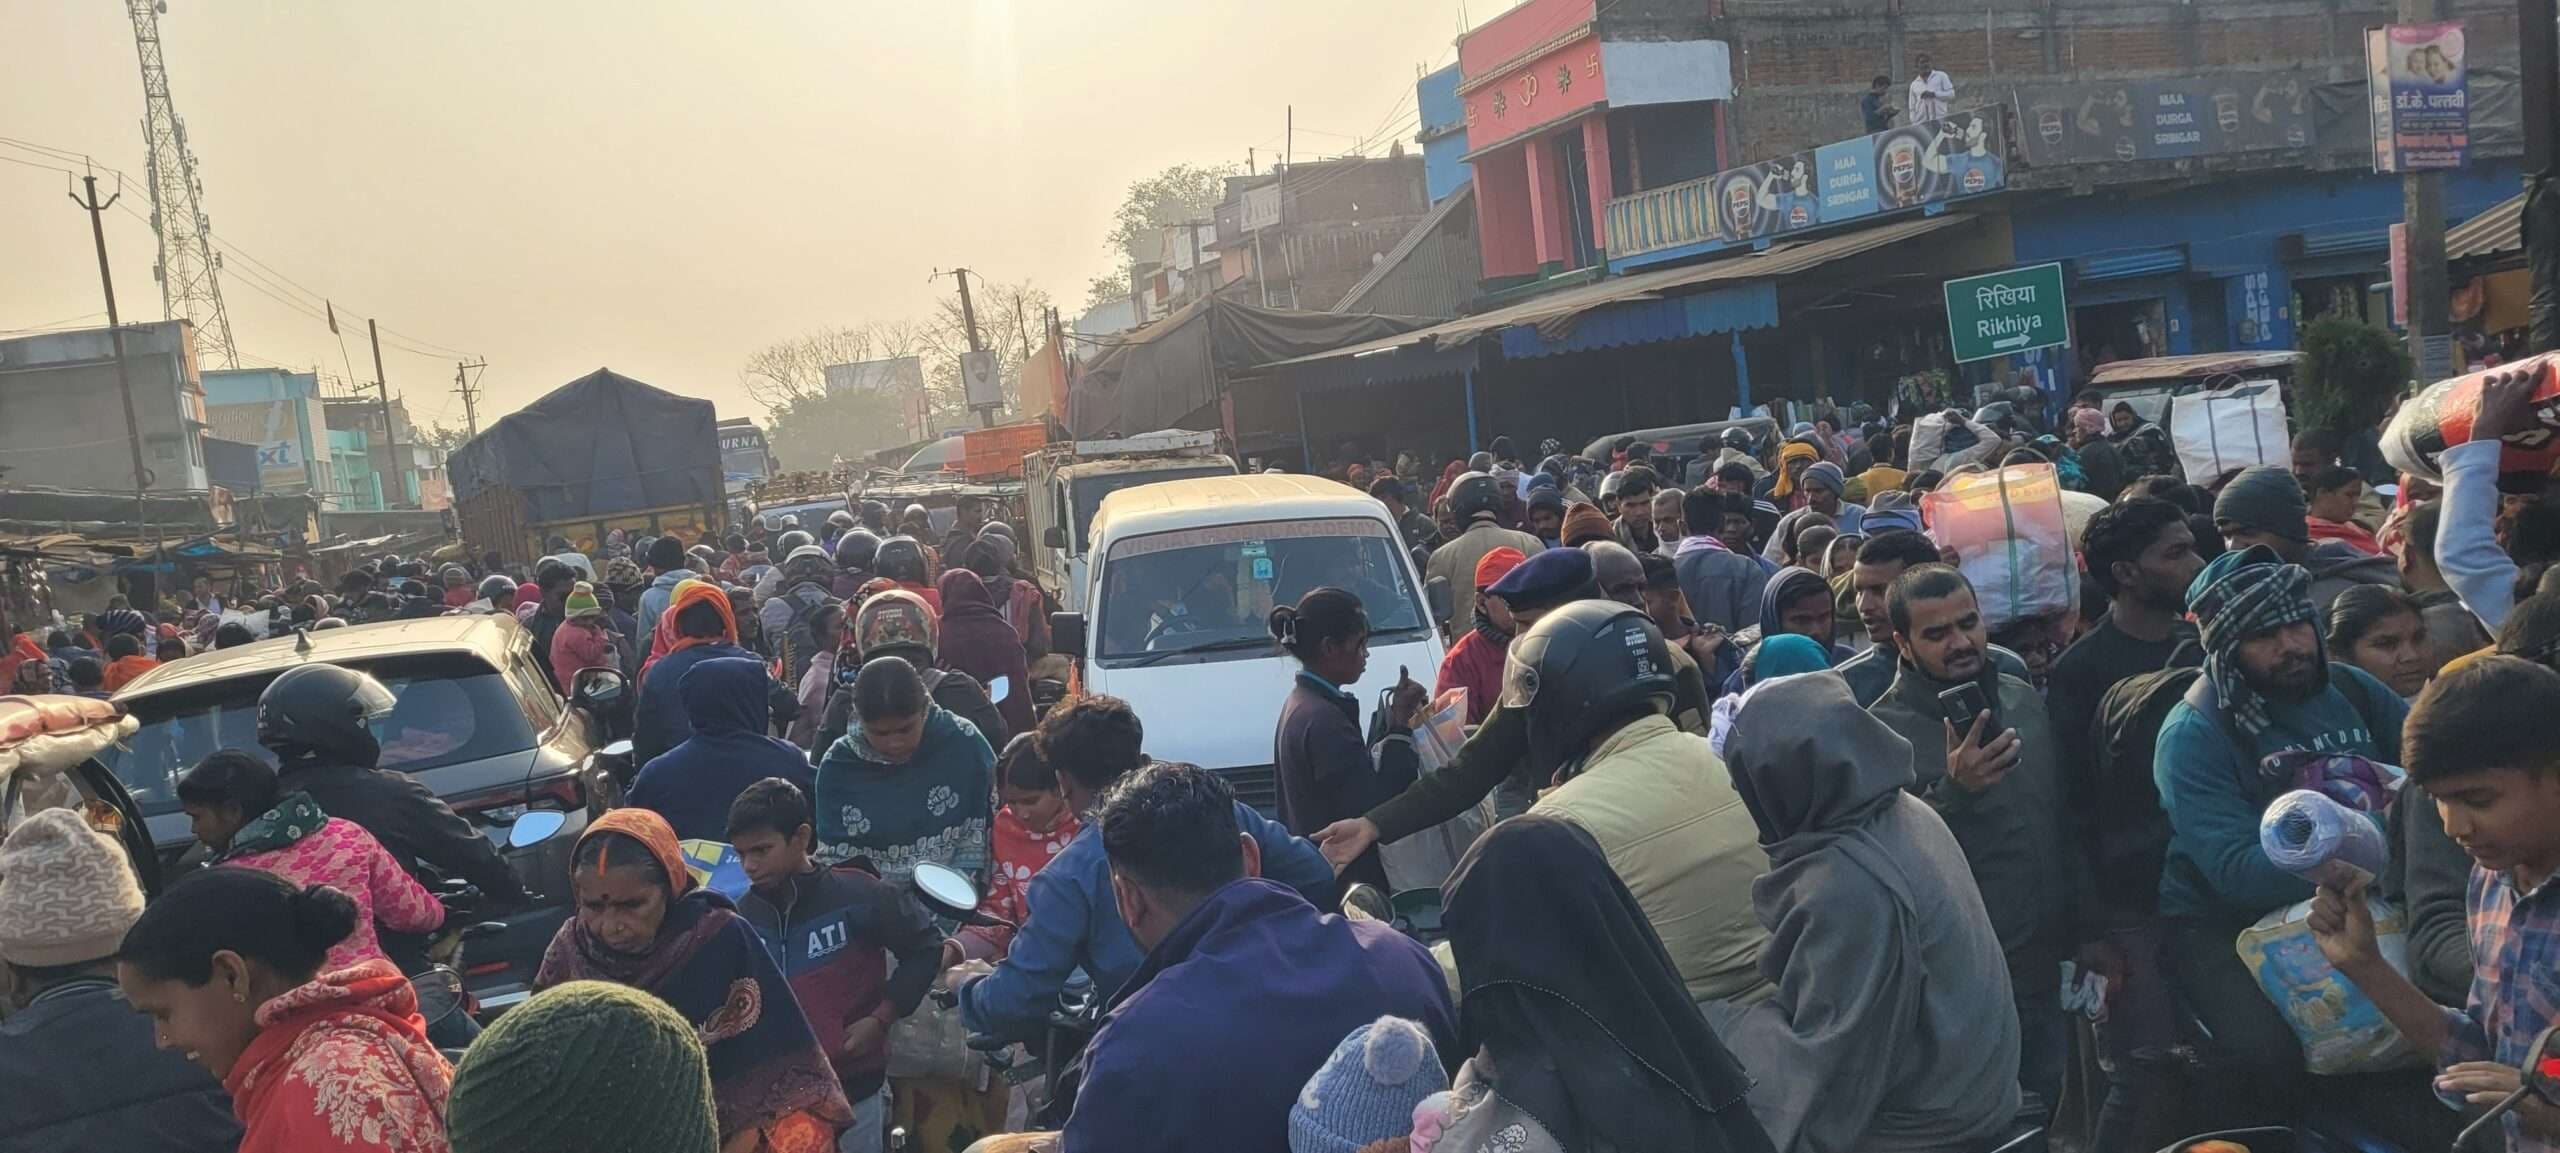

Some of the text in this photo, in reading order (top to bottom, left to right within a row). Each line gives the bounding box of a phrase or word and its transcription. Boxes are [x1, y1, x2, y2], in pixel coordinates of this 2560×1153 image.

[2159, 94, 2185, 106] MAA
[2155, 112, 2193, 126] DURGA
[1833, 155, 1857, 170] MAA
[1830, 171, 1865, 189] DURGA
[1976, 283, 2036, 312] रिखिया
[1976, 313, 2042, 338] Rikhiya
[1287, 519, 1377, 536] ACADEMY
[807, 921, 847, 955] ATI
